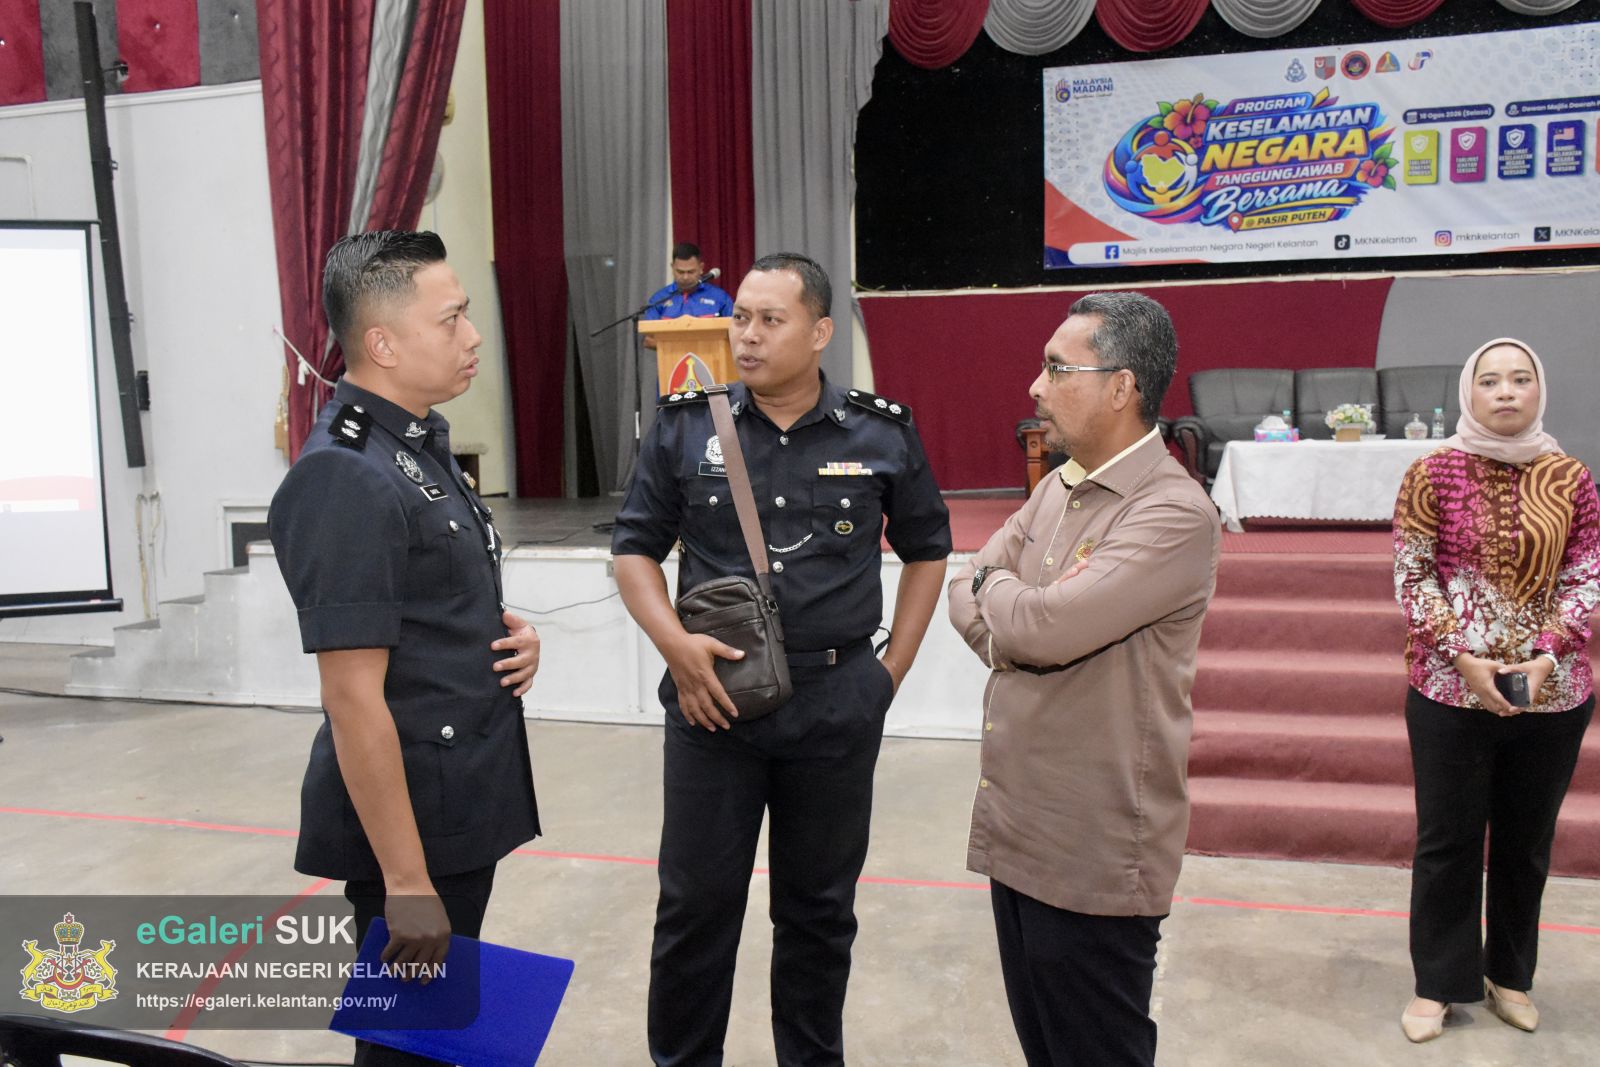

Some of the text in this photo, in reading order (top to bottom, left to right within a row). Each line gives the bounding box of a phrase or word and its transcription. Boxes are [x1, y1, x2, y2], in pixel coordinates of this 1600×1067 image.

[1073, 77, 1113, 86] MALAYSIA
[1073, 84, 1114, 94] MADANI
[1234, 96, 1307, 114] PROGRAM
[1547, 103, 1568, 111] Majlis
[1206, 107, 1373, 141] KESELAMATAN
[1200, 128, 1369, 171] NEGARA
[1215, 162, 1345, 186] TANGGUNGJAWAB
[1200, 178, 1349, 226] Bersama
[1257, 214, 1289, 226] PASIR
[1291, 210, 1327, 222] PUTEH
[1354, 235, 1418, 245] MKNKelantan
[1456, 231, 1520, 242] mknkelantan
[1122, 238, 1319, 256] Majlis Keselamatan Negara Negeri Kelantan
